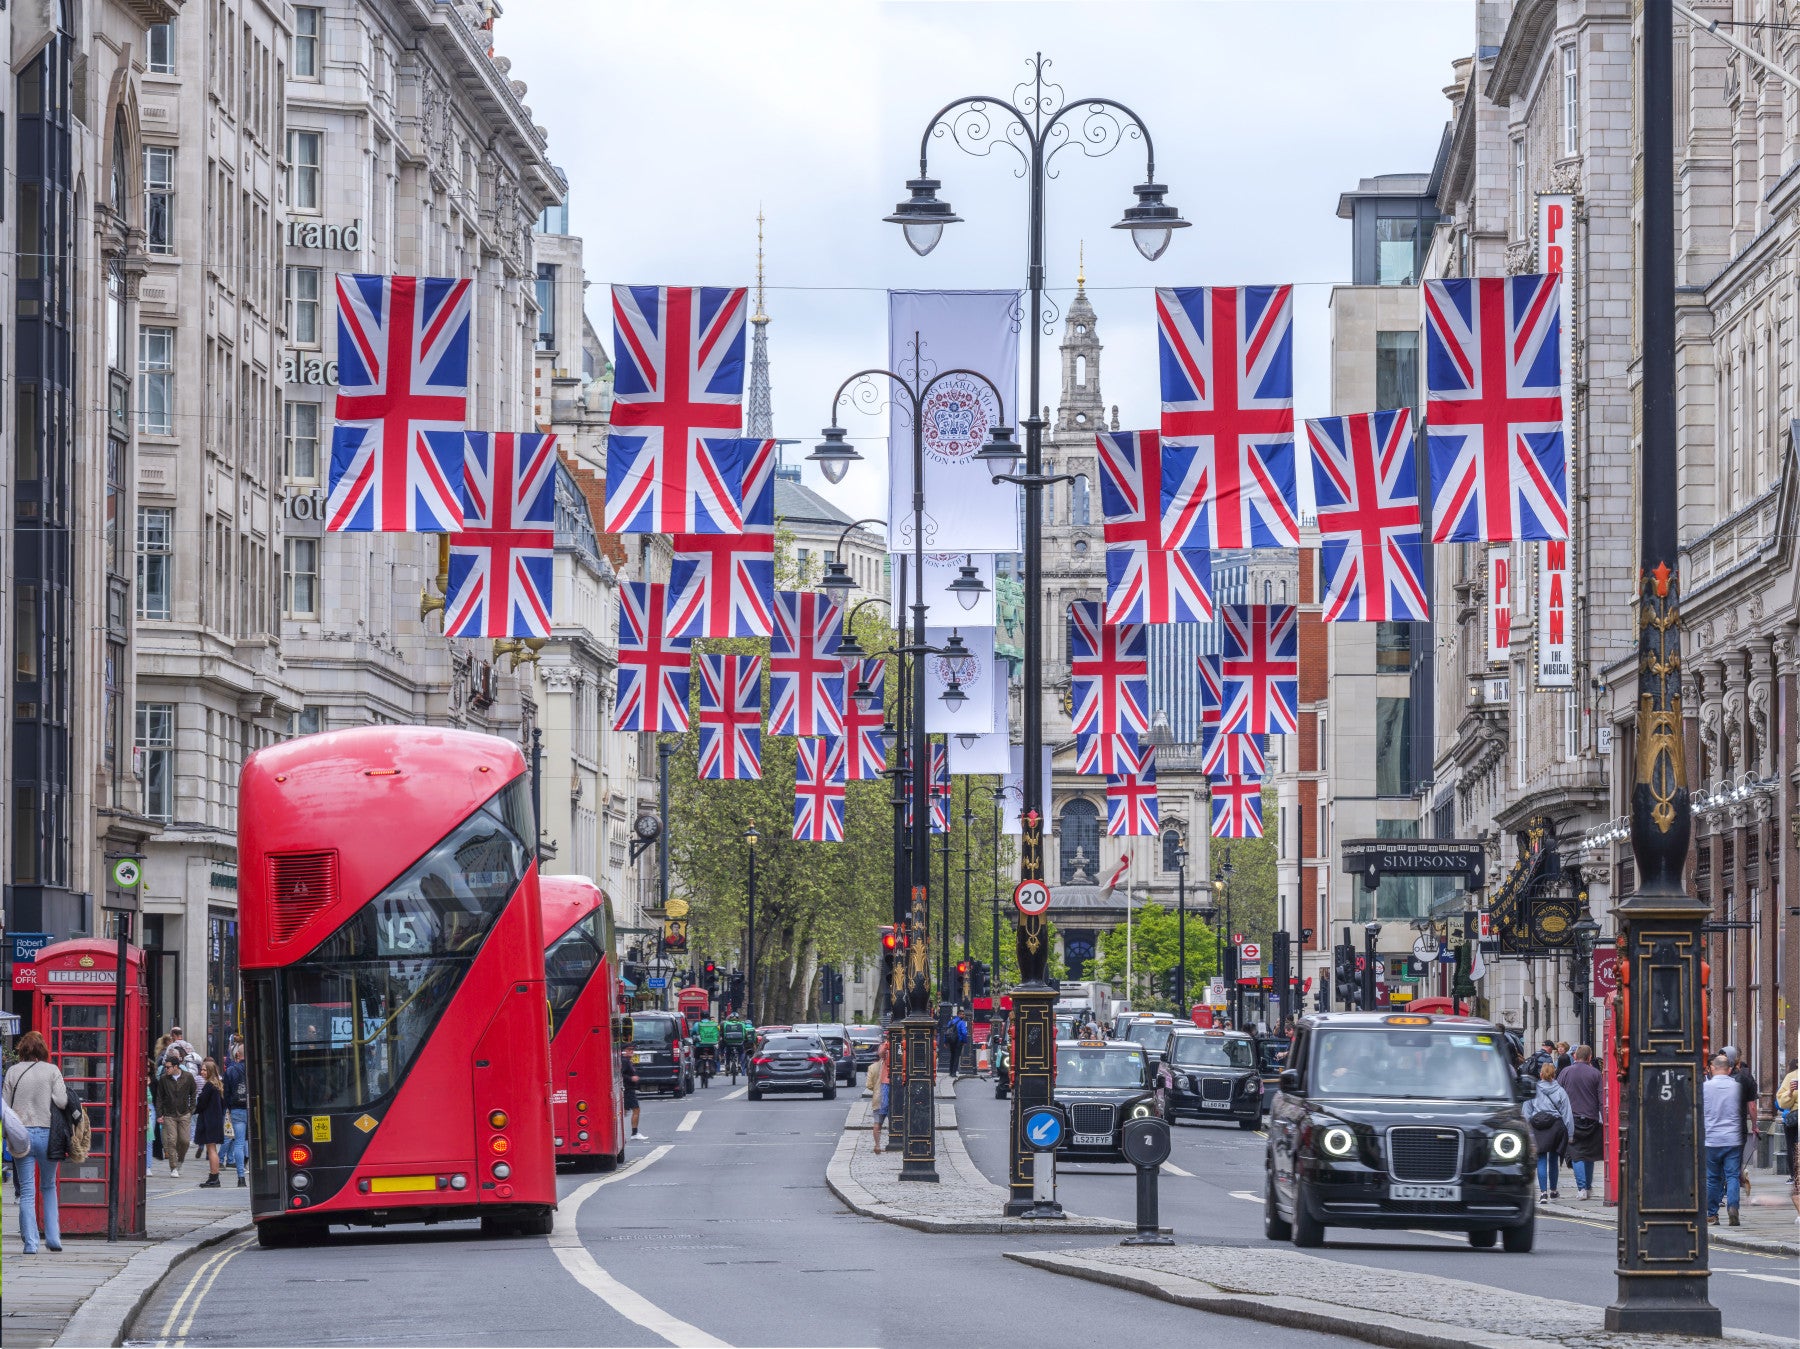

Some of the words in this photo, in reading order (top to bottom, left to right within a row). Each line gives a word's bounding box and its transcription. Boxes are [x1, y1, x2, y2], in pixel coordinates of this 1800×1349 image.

[285, 350, 339, 386] alac
[1547, 541, 1566, 644] MAN
[1551, 651, 1561, 662] THE
[1543, 663, 1570, 675] MUSICAL
[1383, 855, 1467, 867] SIMPSON'S
[1021, 890, 1045, 905] 20
[387, 916, 416, 949] 15
[16, 939, 43, 947] Robert
[15, 976, 37, 984] OFFIC
[52, 971, 116, 982] TELEPHON
